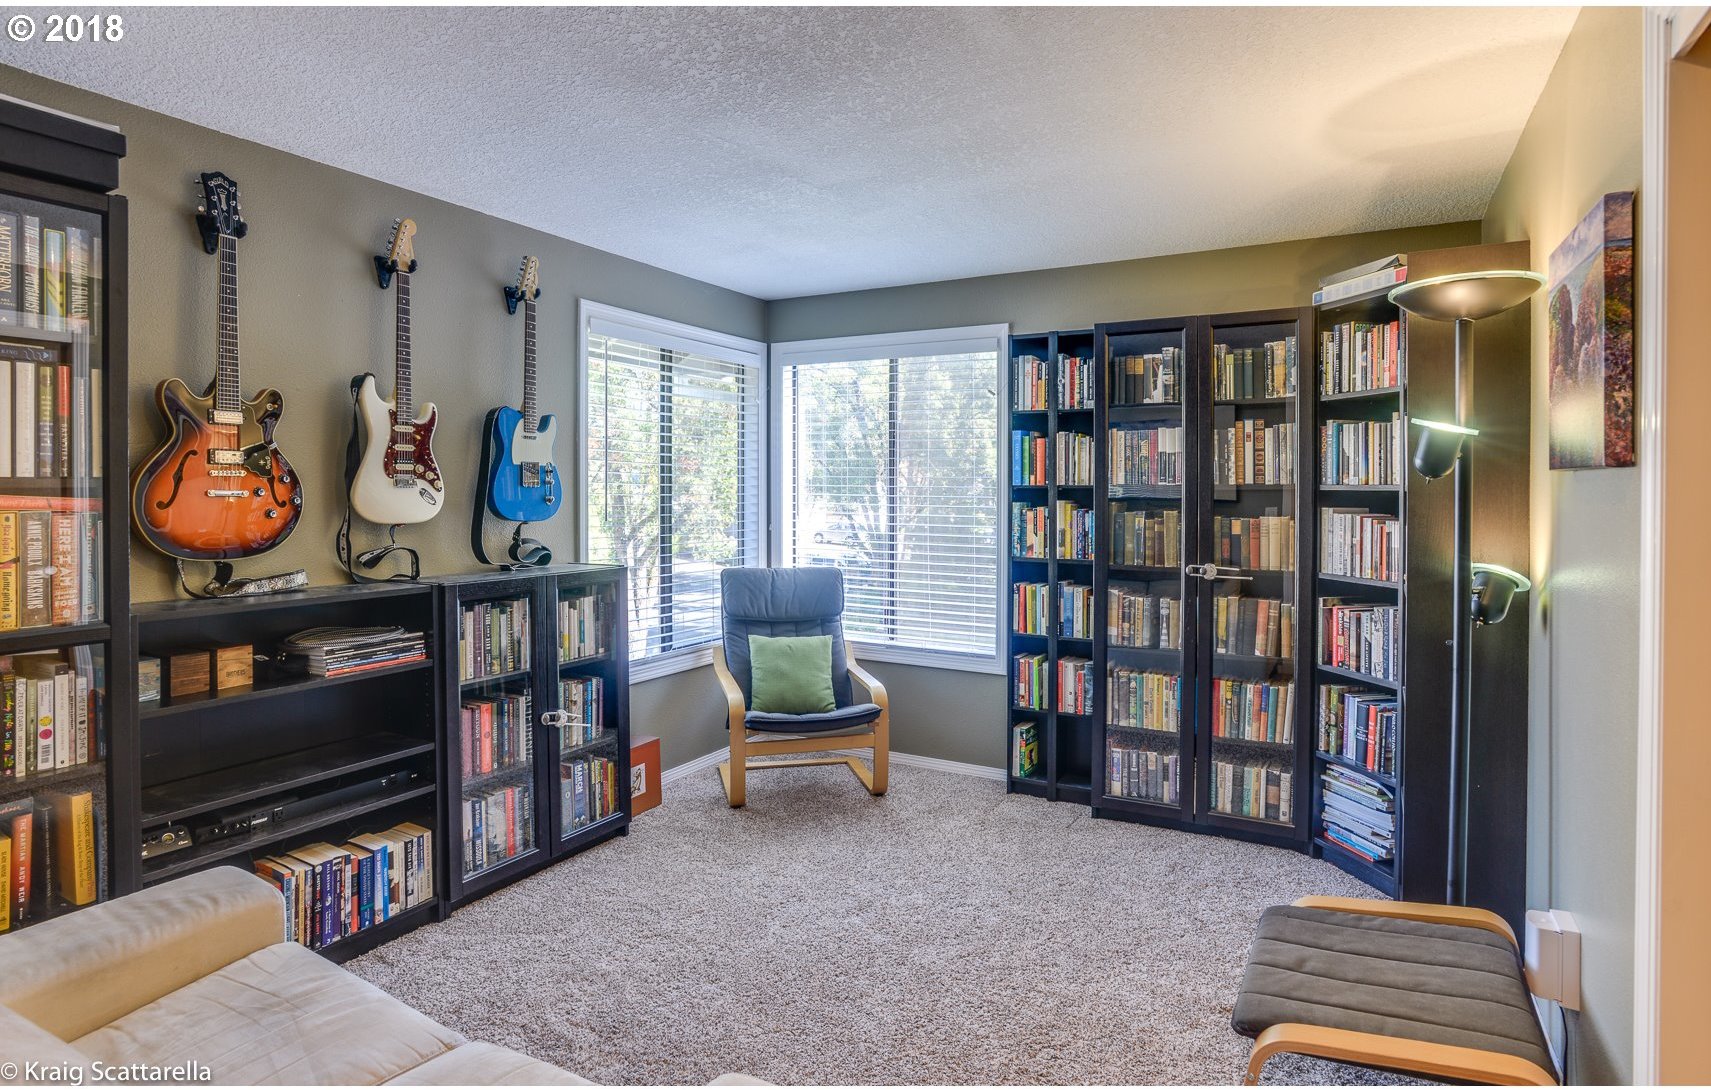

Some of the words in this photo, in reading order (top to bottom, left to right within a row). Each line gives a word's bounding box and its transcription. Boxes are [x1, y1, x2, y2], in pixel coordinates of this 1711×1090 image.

[0, 224, 12, 293] MATTERHORN
[27, 520, 42, 540] ANNIE
[59, 519, 72, 553] HERE
[27, 542, 42, 566] PROULX
[59, 554, 72, 564] I
[2, 571, 12, 612] Homegoing
[26, 570, 44, 610] BARKSKINS
[59, 567, 72, 586] AM
[82, 800, 93, 838] Shakespeare
[85, 838, 93, 850] and
[83, 850, 95, 882] Company
